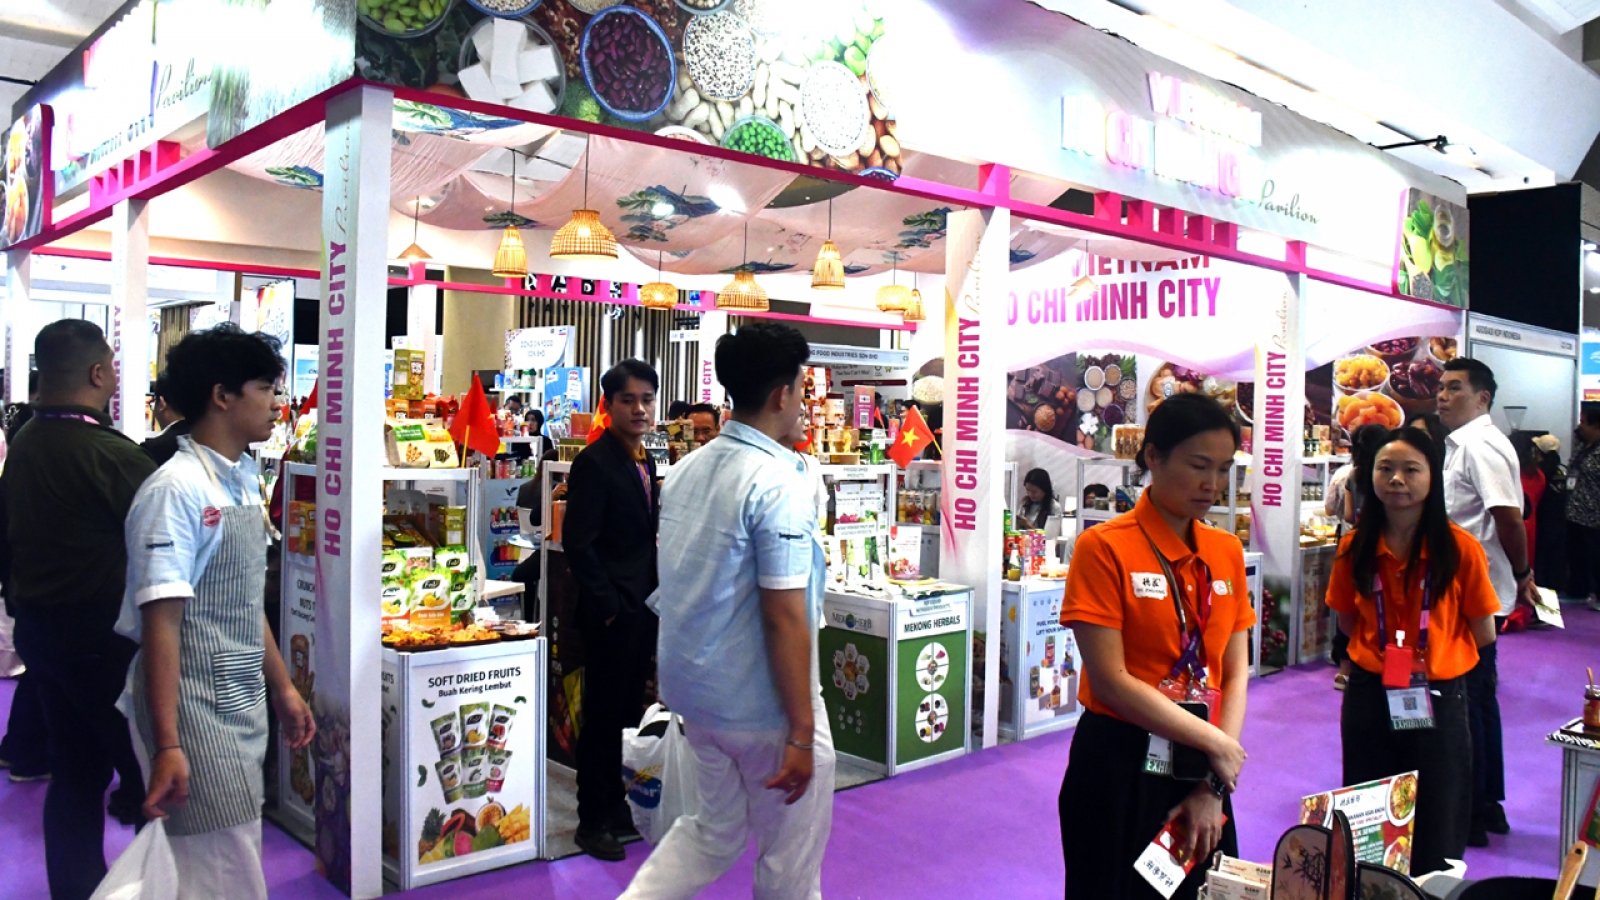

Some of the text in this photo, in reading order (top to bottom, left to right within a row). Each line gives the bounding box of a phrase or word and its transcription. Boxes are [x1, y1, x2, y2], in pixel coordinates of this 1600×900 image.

[1256, 178, 1320, 225] Pavilion
[1008, 277, 1221, 326] O CHI MINH CITY
[816, 349, 830, 357] FOOD
[702, 359, 712, 385] CITY
[324, 241, 346, 556] HO CHI MINH CITY
[955, 317, 980, 531] HO CHI MINH CITY
[1262, 351, 1287, 507] HO CHI MINH CITY
[904, 615, 961, 634] MEKONG HERBALS
[428, 666, 521, 688] SOFT DRIED FRUITS
[438, 680, 511, 698] Buah Kering Lembut
